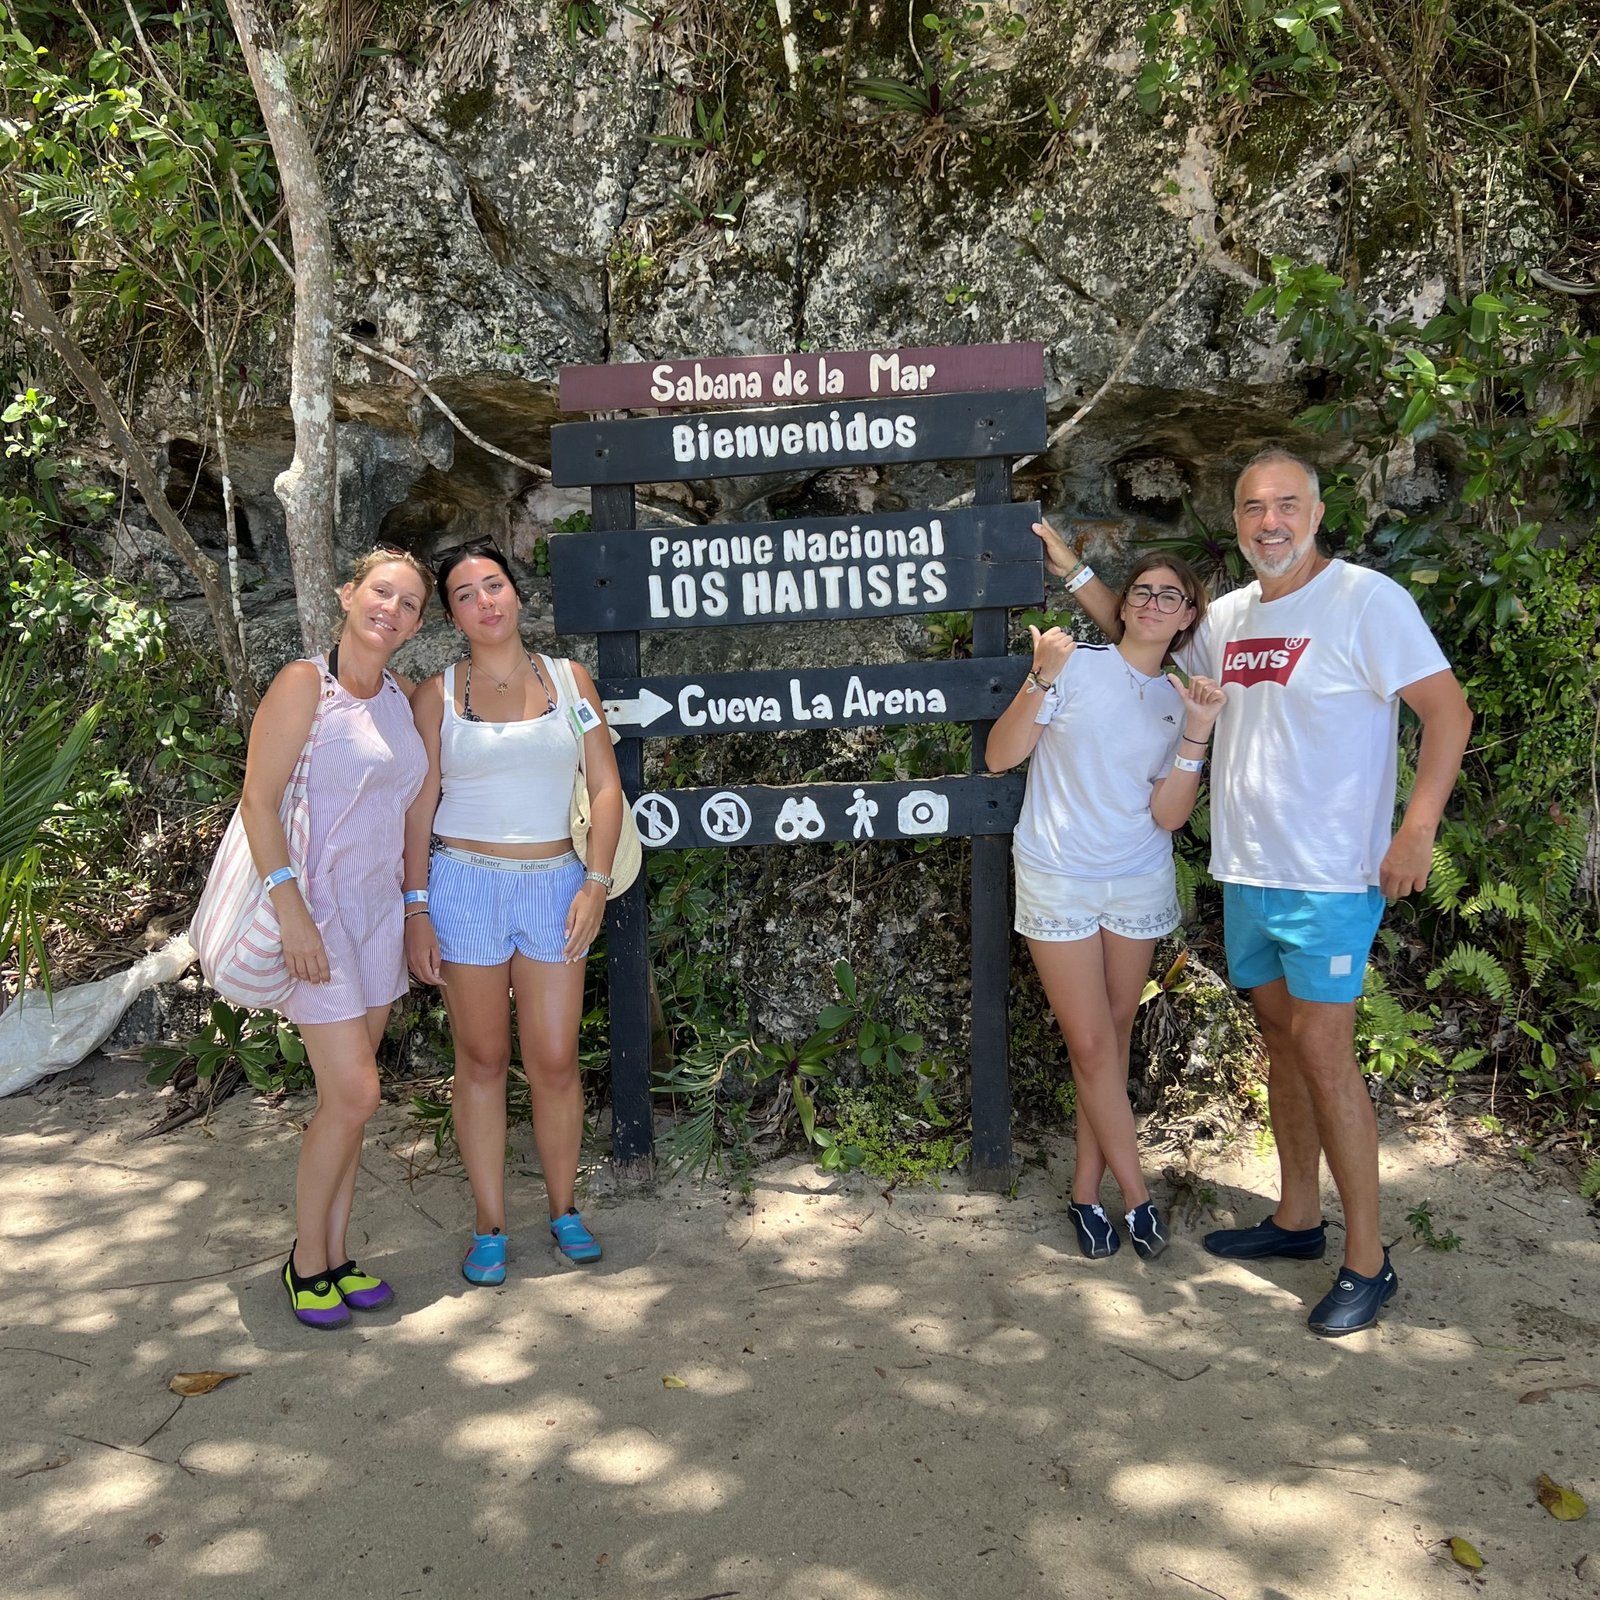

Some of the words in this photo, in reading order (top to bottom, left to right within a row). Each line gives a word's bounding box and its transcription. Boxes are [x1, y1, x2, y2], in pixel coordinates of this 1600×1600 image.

[650, 363, 762, 401] Sabana
[772, 358, 808, 396] de
[819, 357, 844, 395] la
[869, 353, 936, 392] Mar
[672, 411, 917, 462] Bienvenidos
[650, 535, 774, 569] Parque
[783, 519, 945, 560] Nacional
[648, 570, 729, 619] LOS
[742, 561, 948, 615] HAITISES
[677, 684, 782, 727] Cueva
[789, 678, 834, 721] La
[842, 675, 947, 718] Arena
[470, 855, 501, 868] Hollister
[520, 863, 550, 871] Hollister
